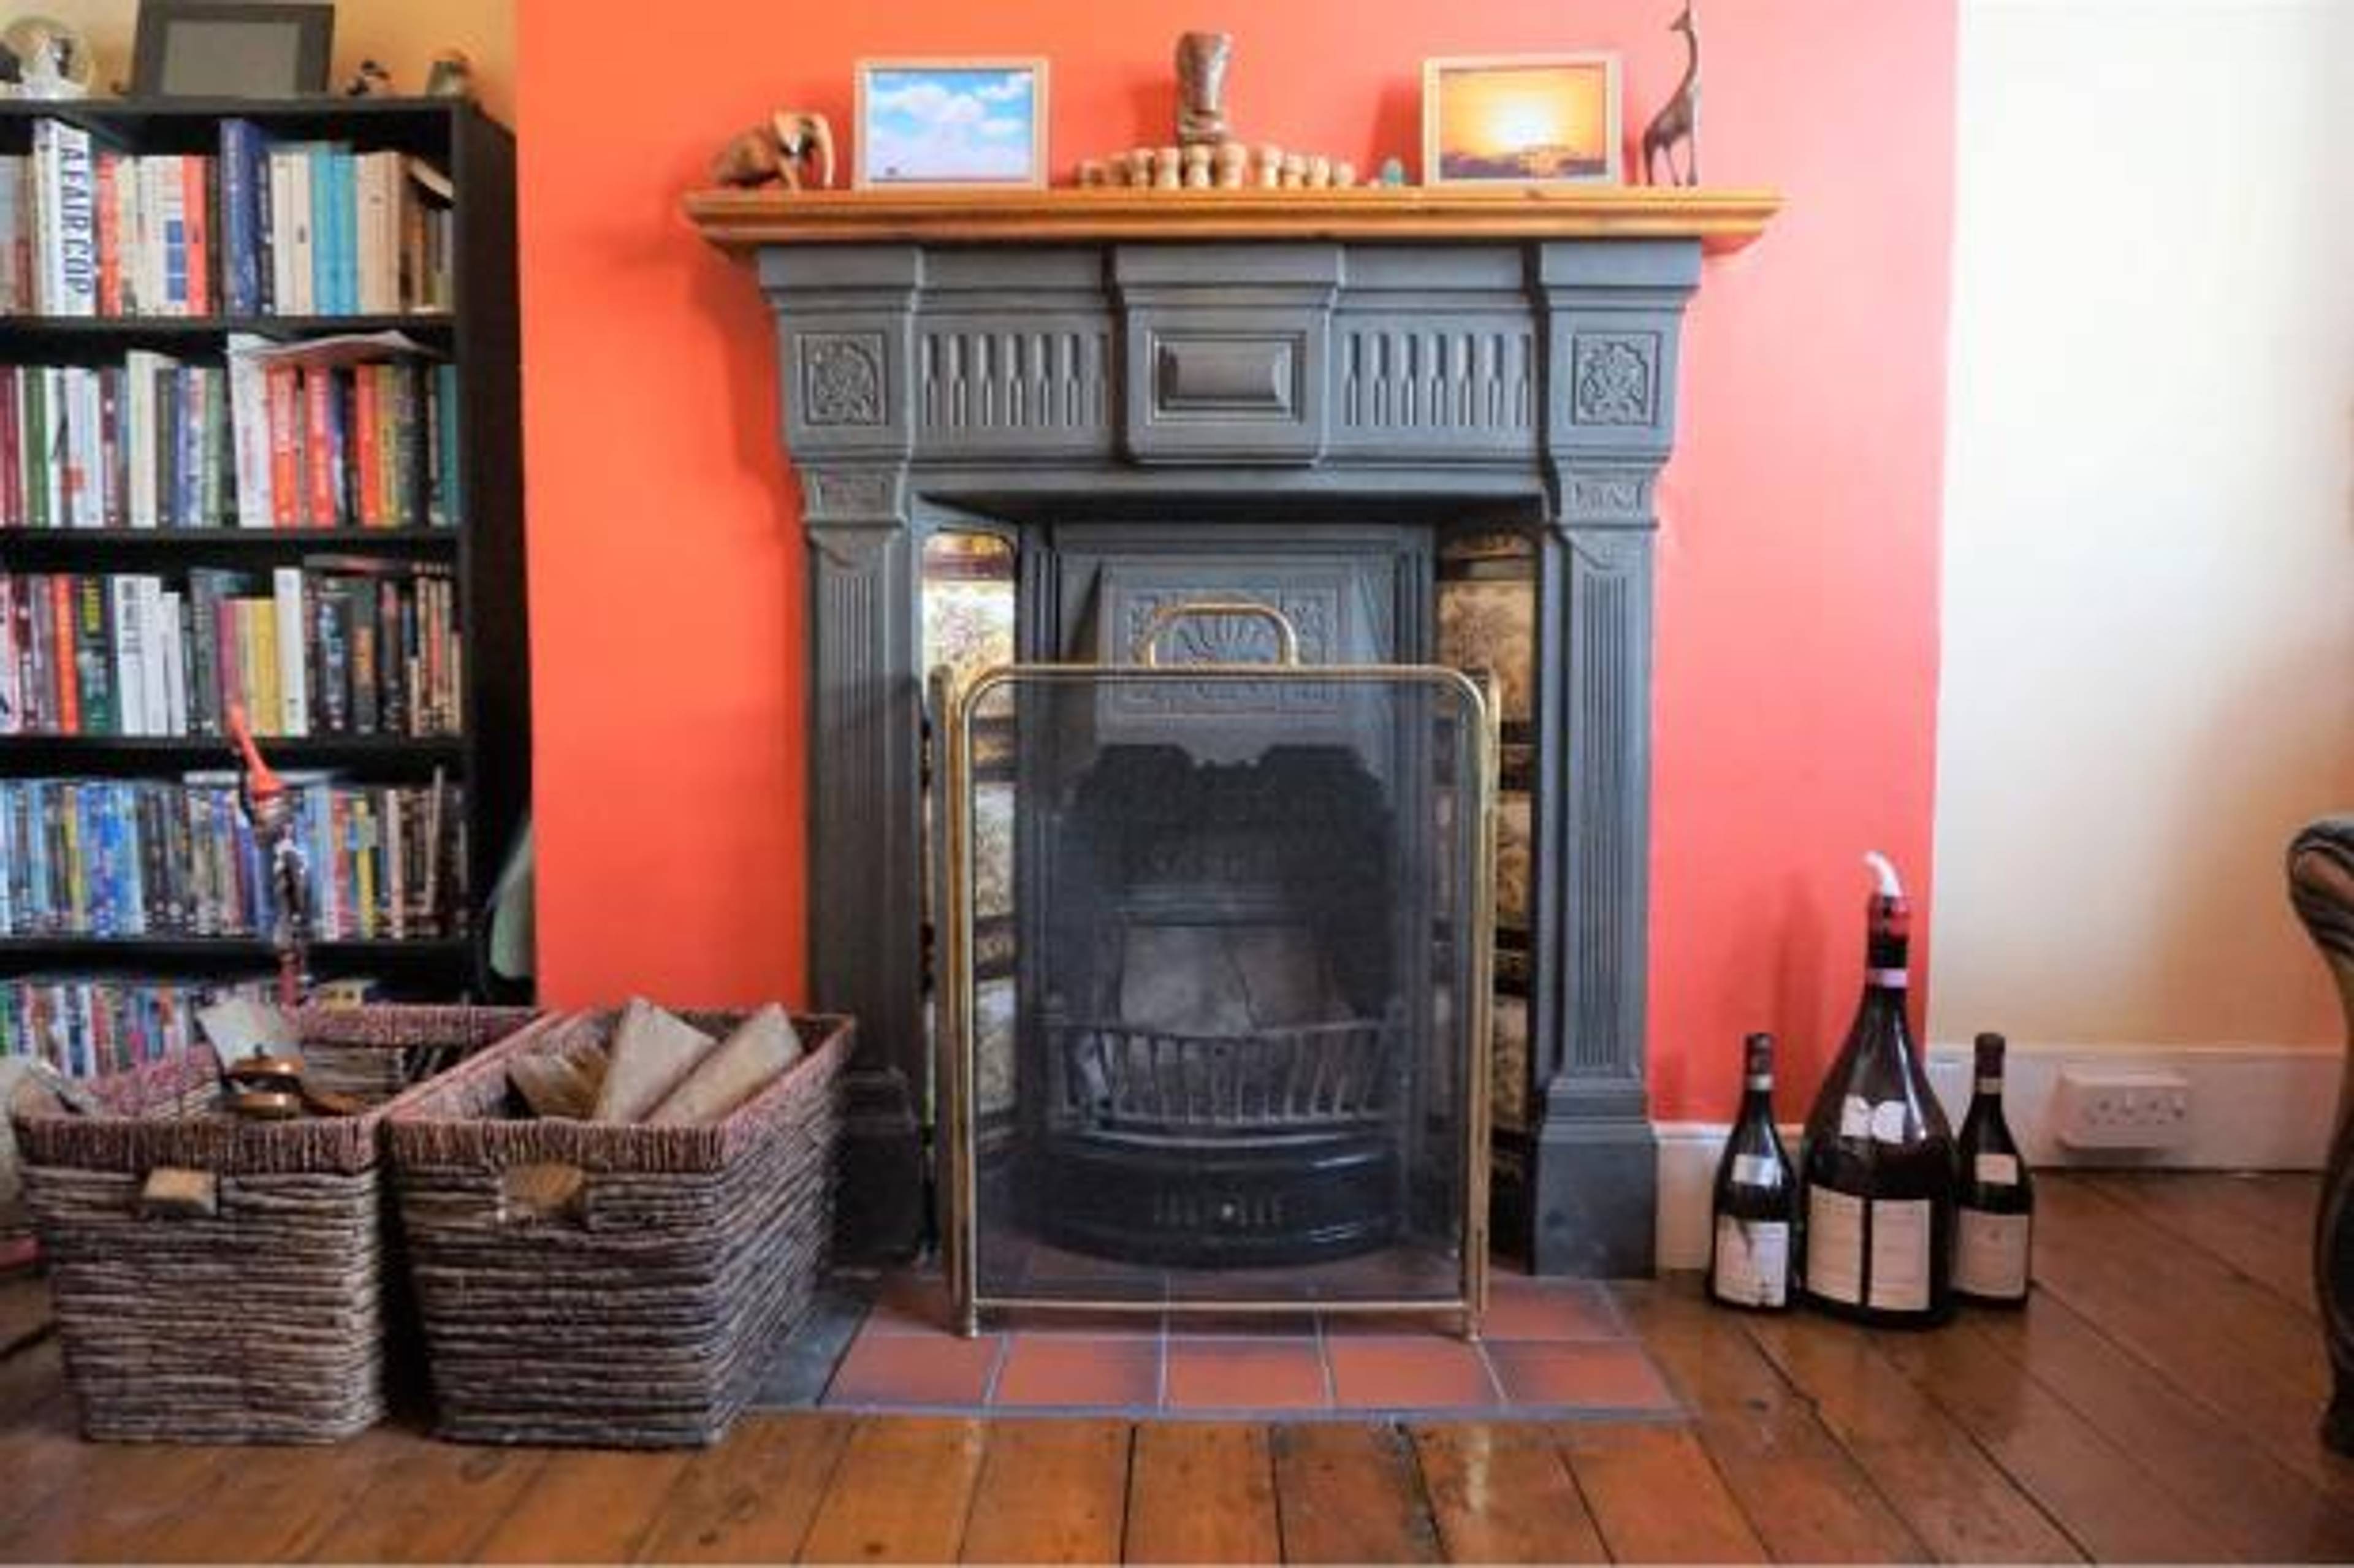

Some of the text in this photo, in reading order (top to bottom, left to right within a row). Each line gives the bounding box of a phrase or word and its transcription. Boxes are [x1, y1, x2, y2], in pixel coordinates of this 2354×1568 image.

[61, 147, 91, 294] A FAIR COP
